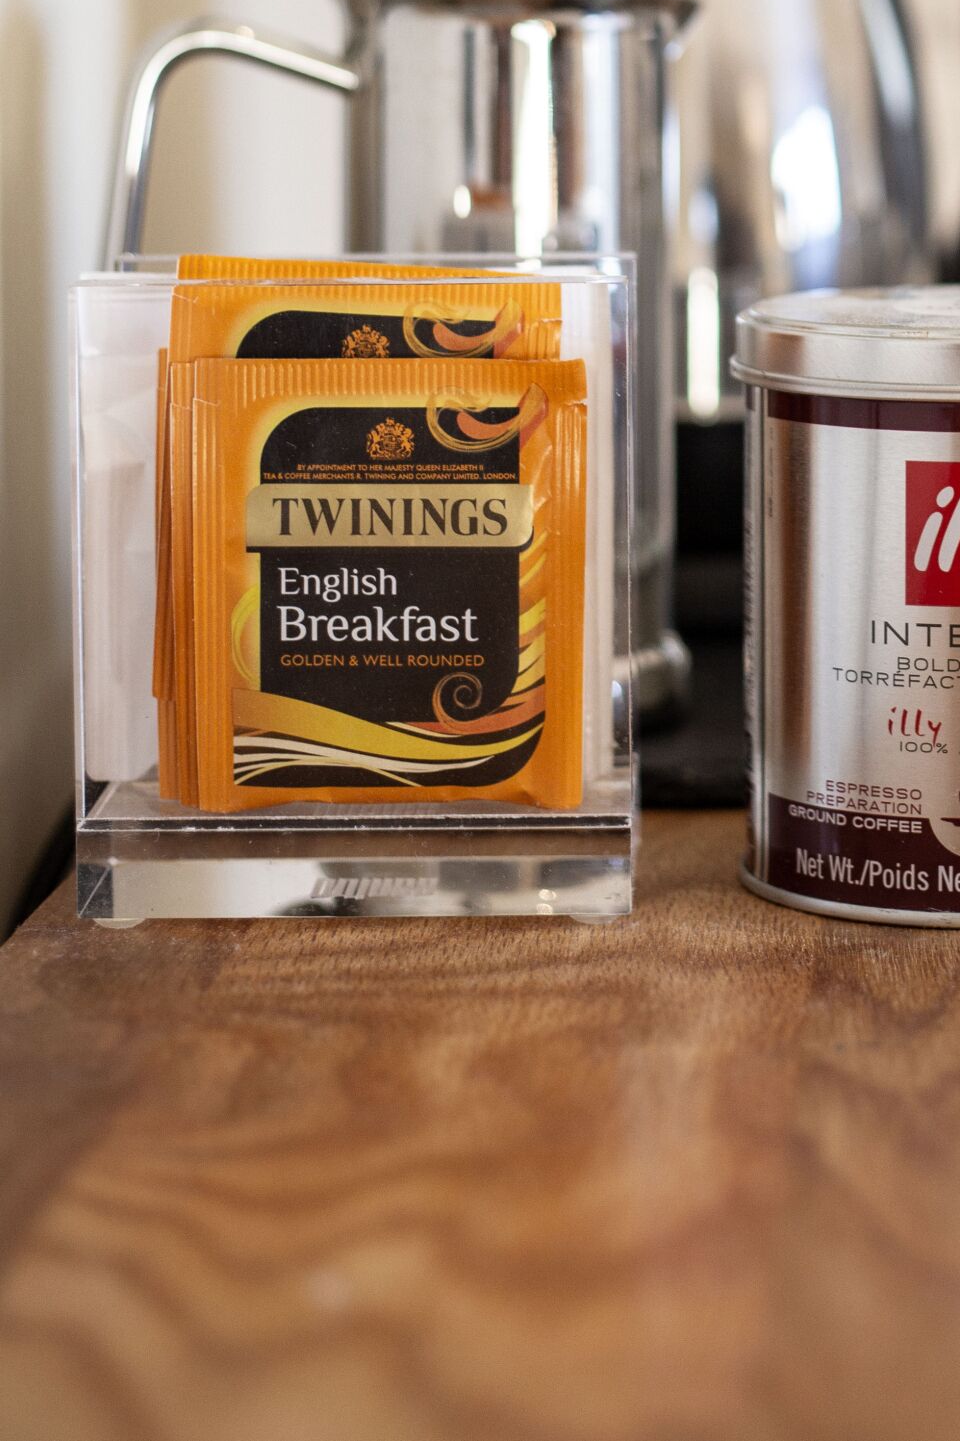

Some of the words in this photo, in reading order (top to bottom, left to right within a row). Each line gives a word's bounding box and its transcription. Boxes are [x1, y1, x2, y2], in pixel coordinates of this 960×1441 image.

[264, 472, 276, 480] TEA
[285, 472, 311, 480] COFFEE
[312, 472, 354, 480] MERCHANTS
[365, 472, 397, 480] TWINING
[398, 472, 414, 480] AND
[415, 472, 452, 480] COMPANY
[296, 463, 306, 471] BY
[307, 463, 356, 472] APPOINTMENT
[358, 463, 368, 472] TO
[369, 463, 383, 472] HER
[384, 463, 415, 472] MAJESTY
[416, 464, 441, 472] QUEEN
[272, 497, 509, 536] TWININGS
[278, 567, 398, 603] English
[276, 605, 479, 642] Breakfast
[280, 654, 344, 667] GOLDEN
[349, 654, 359, 667] &
[364, 654, 403, 667] WELL
[407, 654, 485, 667] ROUNDED
[888, 707, 942, 743] illy
[900, 741, 948, 754] 100%
[807, 790, 923, 816] PREPARATION
[826, 779, 923, 801] ESPRESSO
[789, 804, 847, 827] GROUND
[852, 816, 923, 834] COFFEE
[796, 848, 824, 880] Net
[829, 854, 930, 892] Wt./Poids
